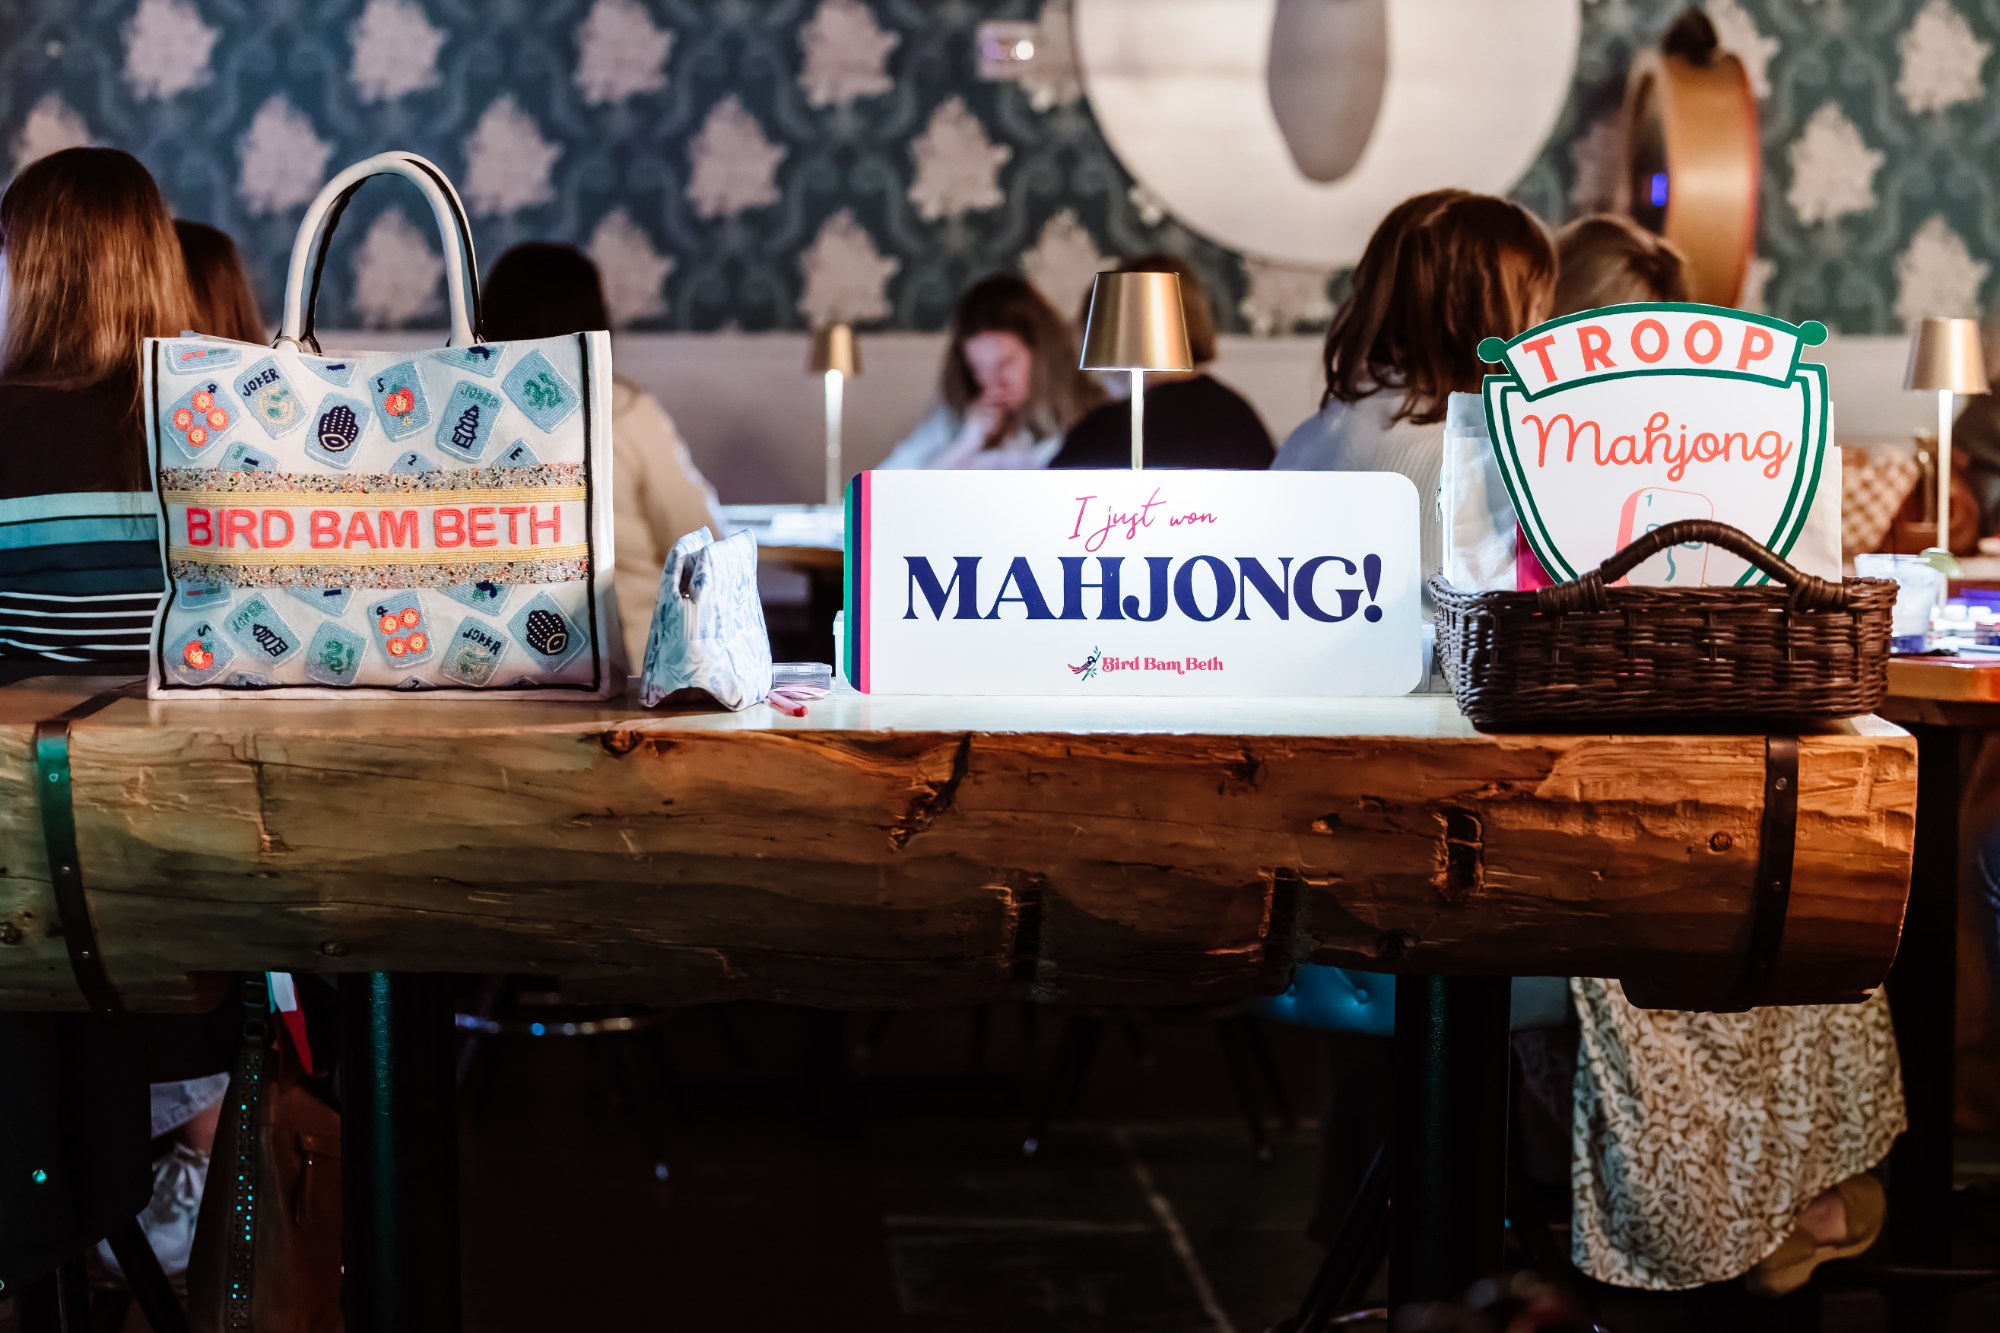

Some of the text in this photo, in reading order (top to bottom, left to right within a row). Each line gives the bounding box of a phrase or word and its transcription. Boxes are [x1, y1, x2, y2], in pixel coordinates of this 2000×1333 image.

[1522, 318, 1775, 383] TROOP
[243, 368, 280, 397] JOKER
[1521, 411, 1793, 482] Mahjong
[185, 505, 561, 549] BIRD BAM BETH
[1068, 487, 1217, 552] I just won
[1646, 493, 1653, 507] 1
[902, 553, 1383, 623] MAHJONG!
[1102, 656, 1224, 675] Bird Bam Beth
